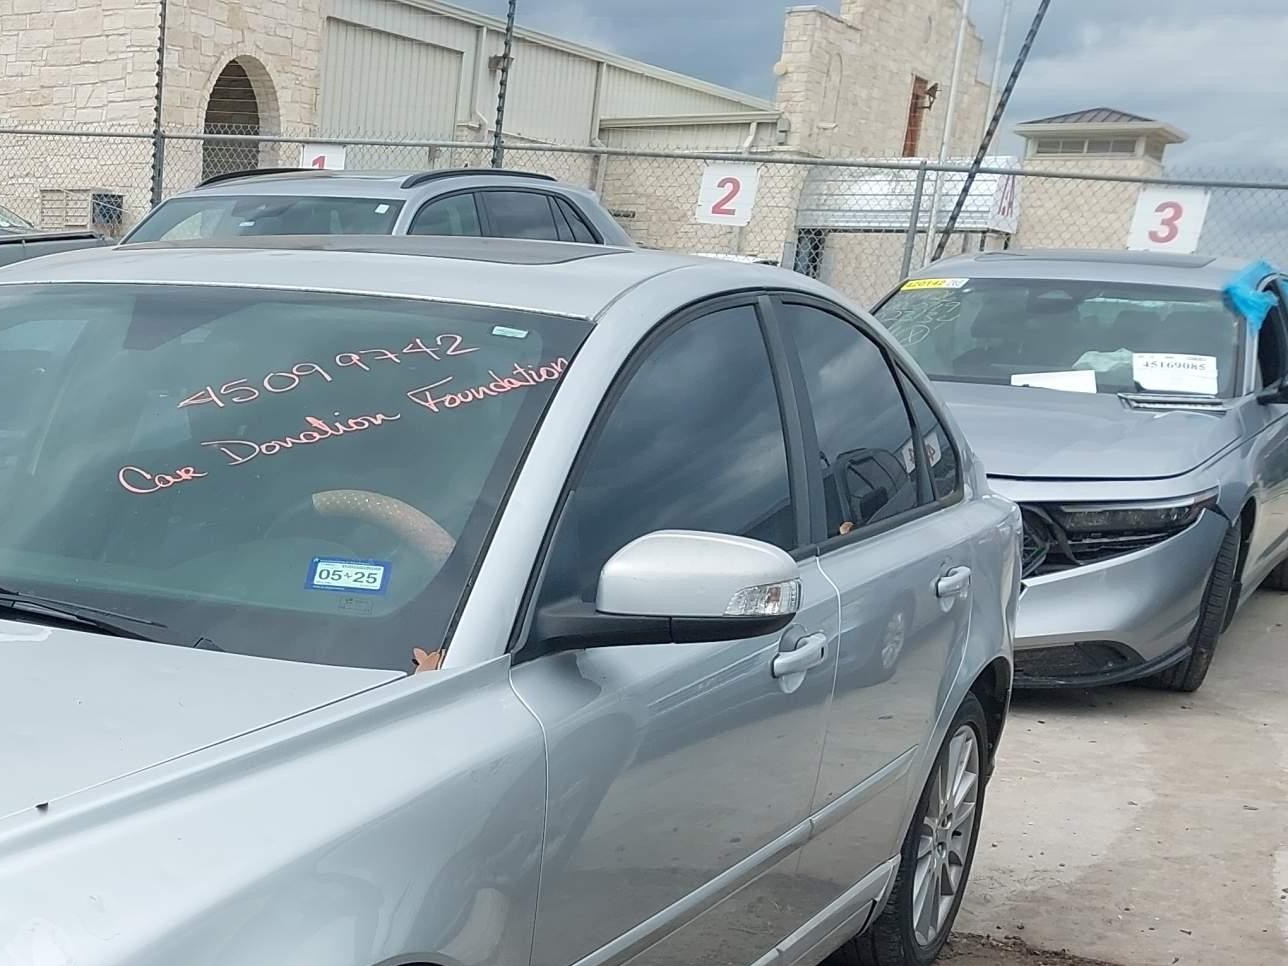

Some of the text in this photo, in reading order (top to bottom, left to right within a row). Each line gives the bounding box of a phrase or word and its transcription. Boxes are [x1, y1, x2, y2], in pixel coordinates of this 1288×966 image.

[711, 176, 741, 216] 2
[1148, 200, 1184, 245] 3
[176, 333, 480, 410] 45099742
[200, 411, 402, 467] Donation
[406, 355, 569, 414] Foundation
[318, 568, 343, 581] 05
[352, 571, 378, 584] 25
